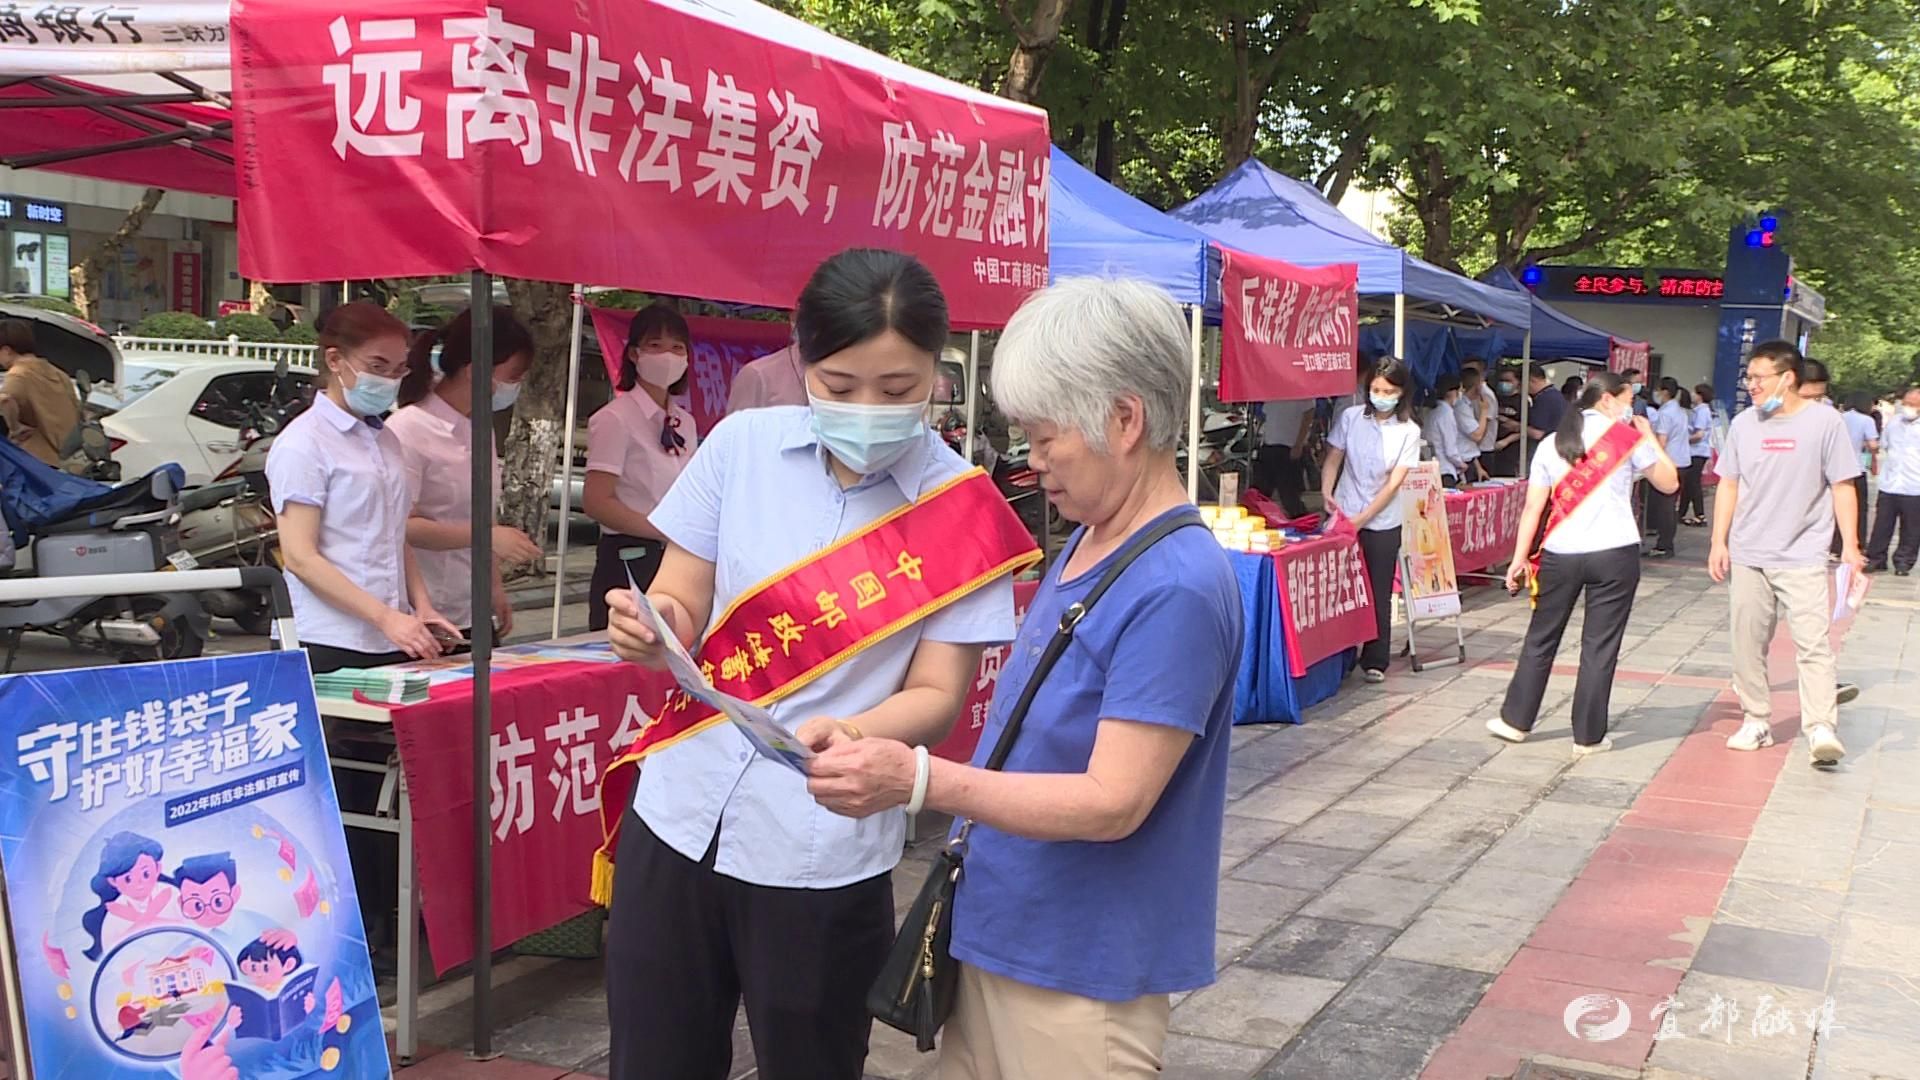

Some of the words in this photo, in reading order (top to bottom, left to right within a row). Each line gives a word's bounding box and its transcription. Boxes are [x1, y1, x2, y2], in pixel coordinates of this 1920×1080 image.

[1242, 276, 1299, 348] 反洗钱
[17, 681, 252, 802] 守住钱袋子
[72, 701, 302, 811] 护好幸福家
[169, 768, 300, 819] 2022年防范非法集资宣传
